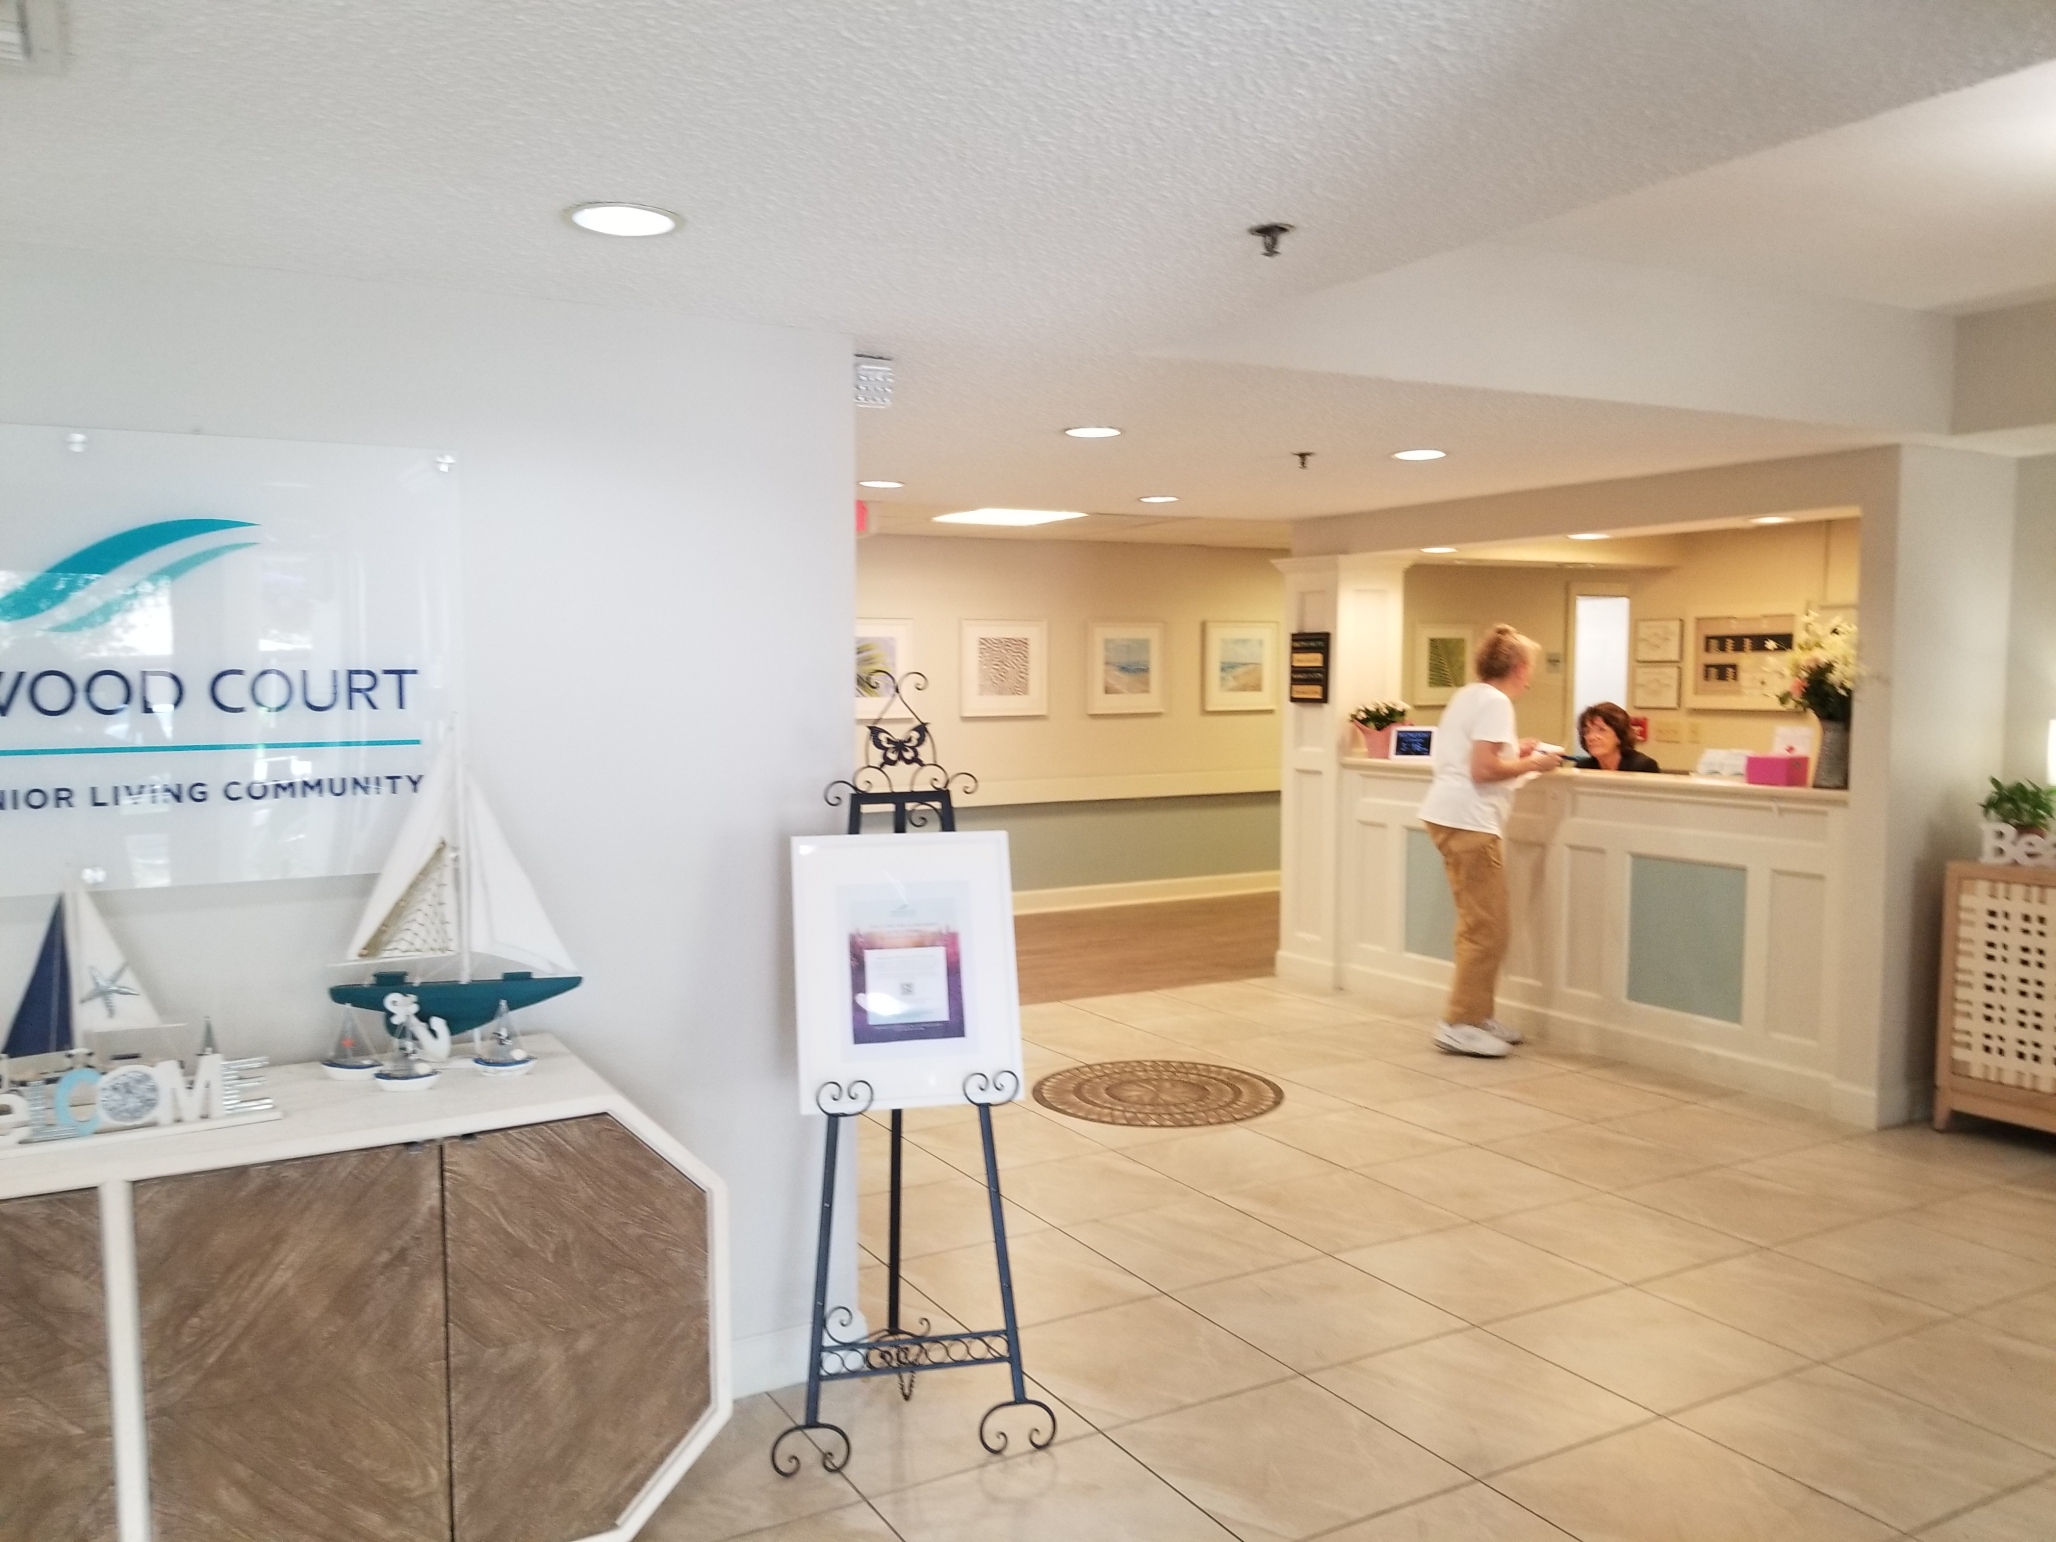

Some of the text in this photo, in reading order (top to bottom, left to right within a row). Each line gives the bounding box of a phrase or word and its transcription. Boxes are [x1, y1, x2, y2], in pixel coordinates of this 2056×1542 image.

[210, 669, 419, 713] COURT
[0, 774, 424, 811] IOR LIVING COMMUNITY
